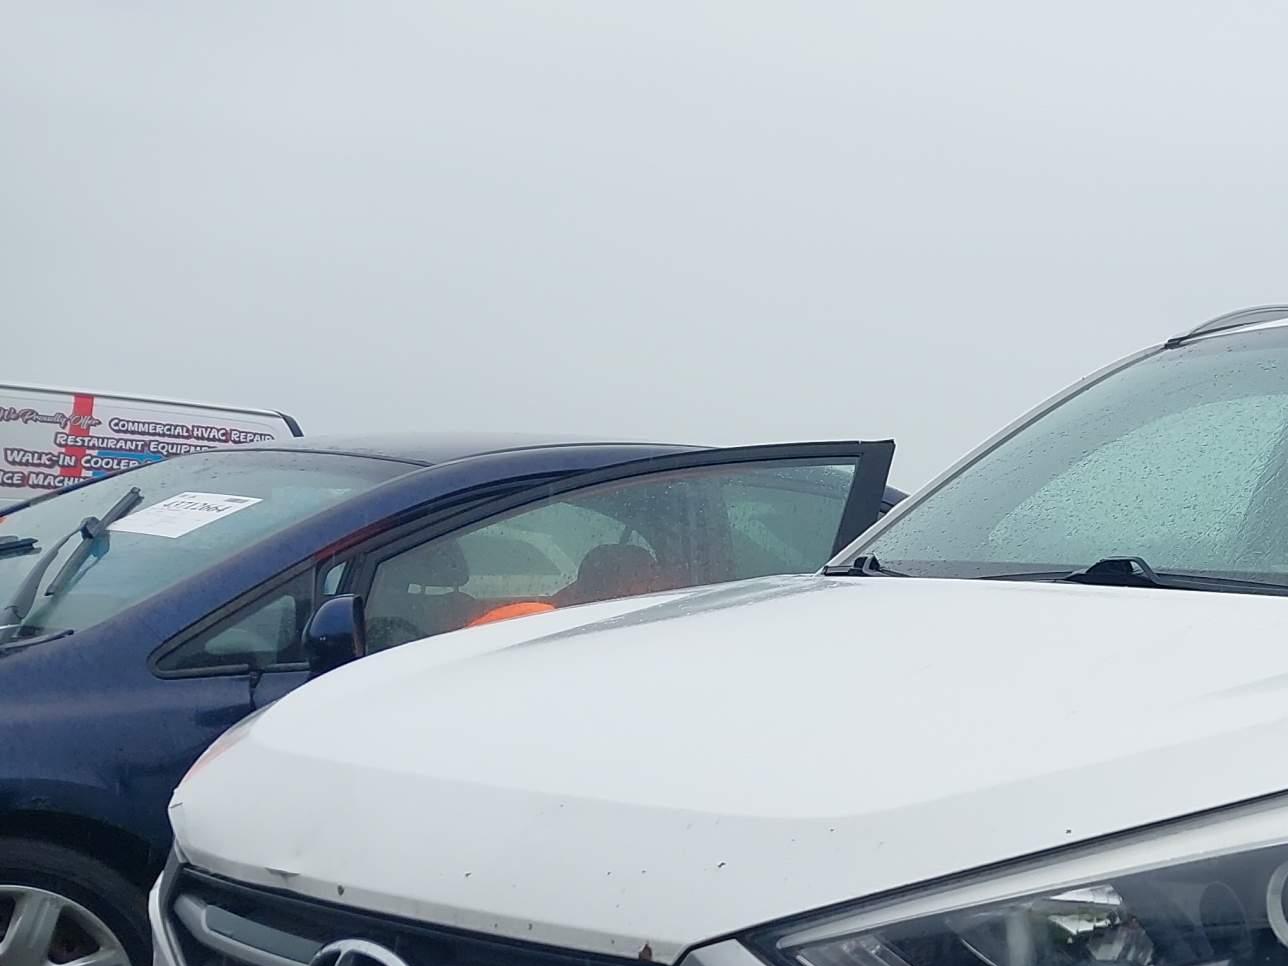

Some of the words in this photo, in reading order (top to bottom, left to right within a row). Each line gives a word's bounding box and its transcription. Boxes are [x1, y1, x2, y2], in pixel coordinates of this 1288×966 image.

[19, 409, 67, 428] Proudly
[70, 413, 101, 428] Offer
[110, 418, 189, 437] COMMERCIAL
[193, 425, 226, 440] HVAC
[55, 433, 144, 451] RESTAURANT
[5, 449, 75, 467] WALK-IN
